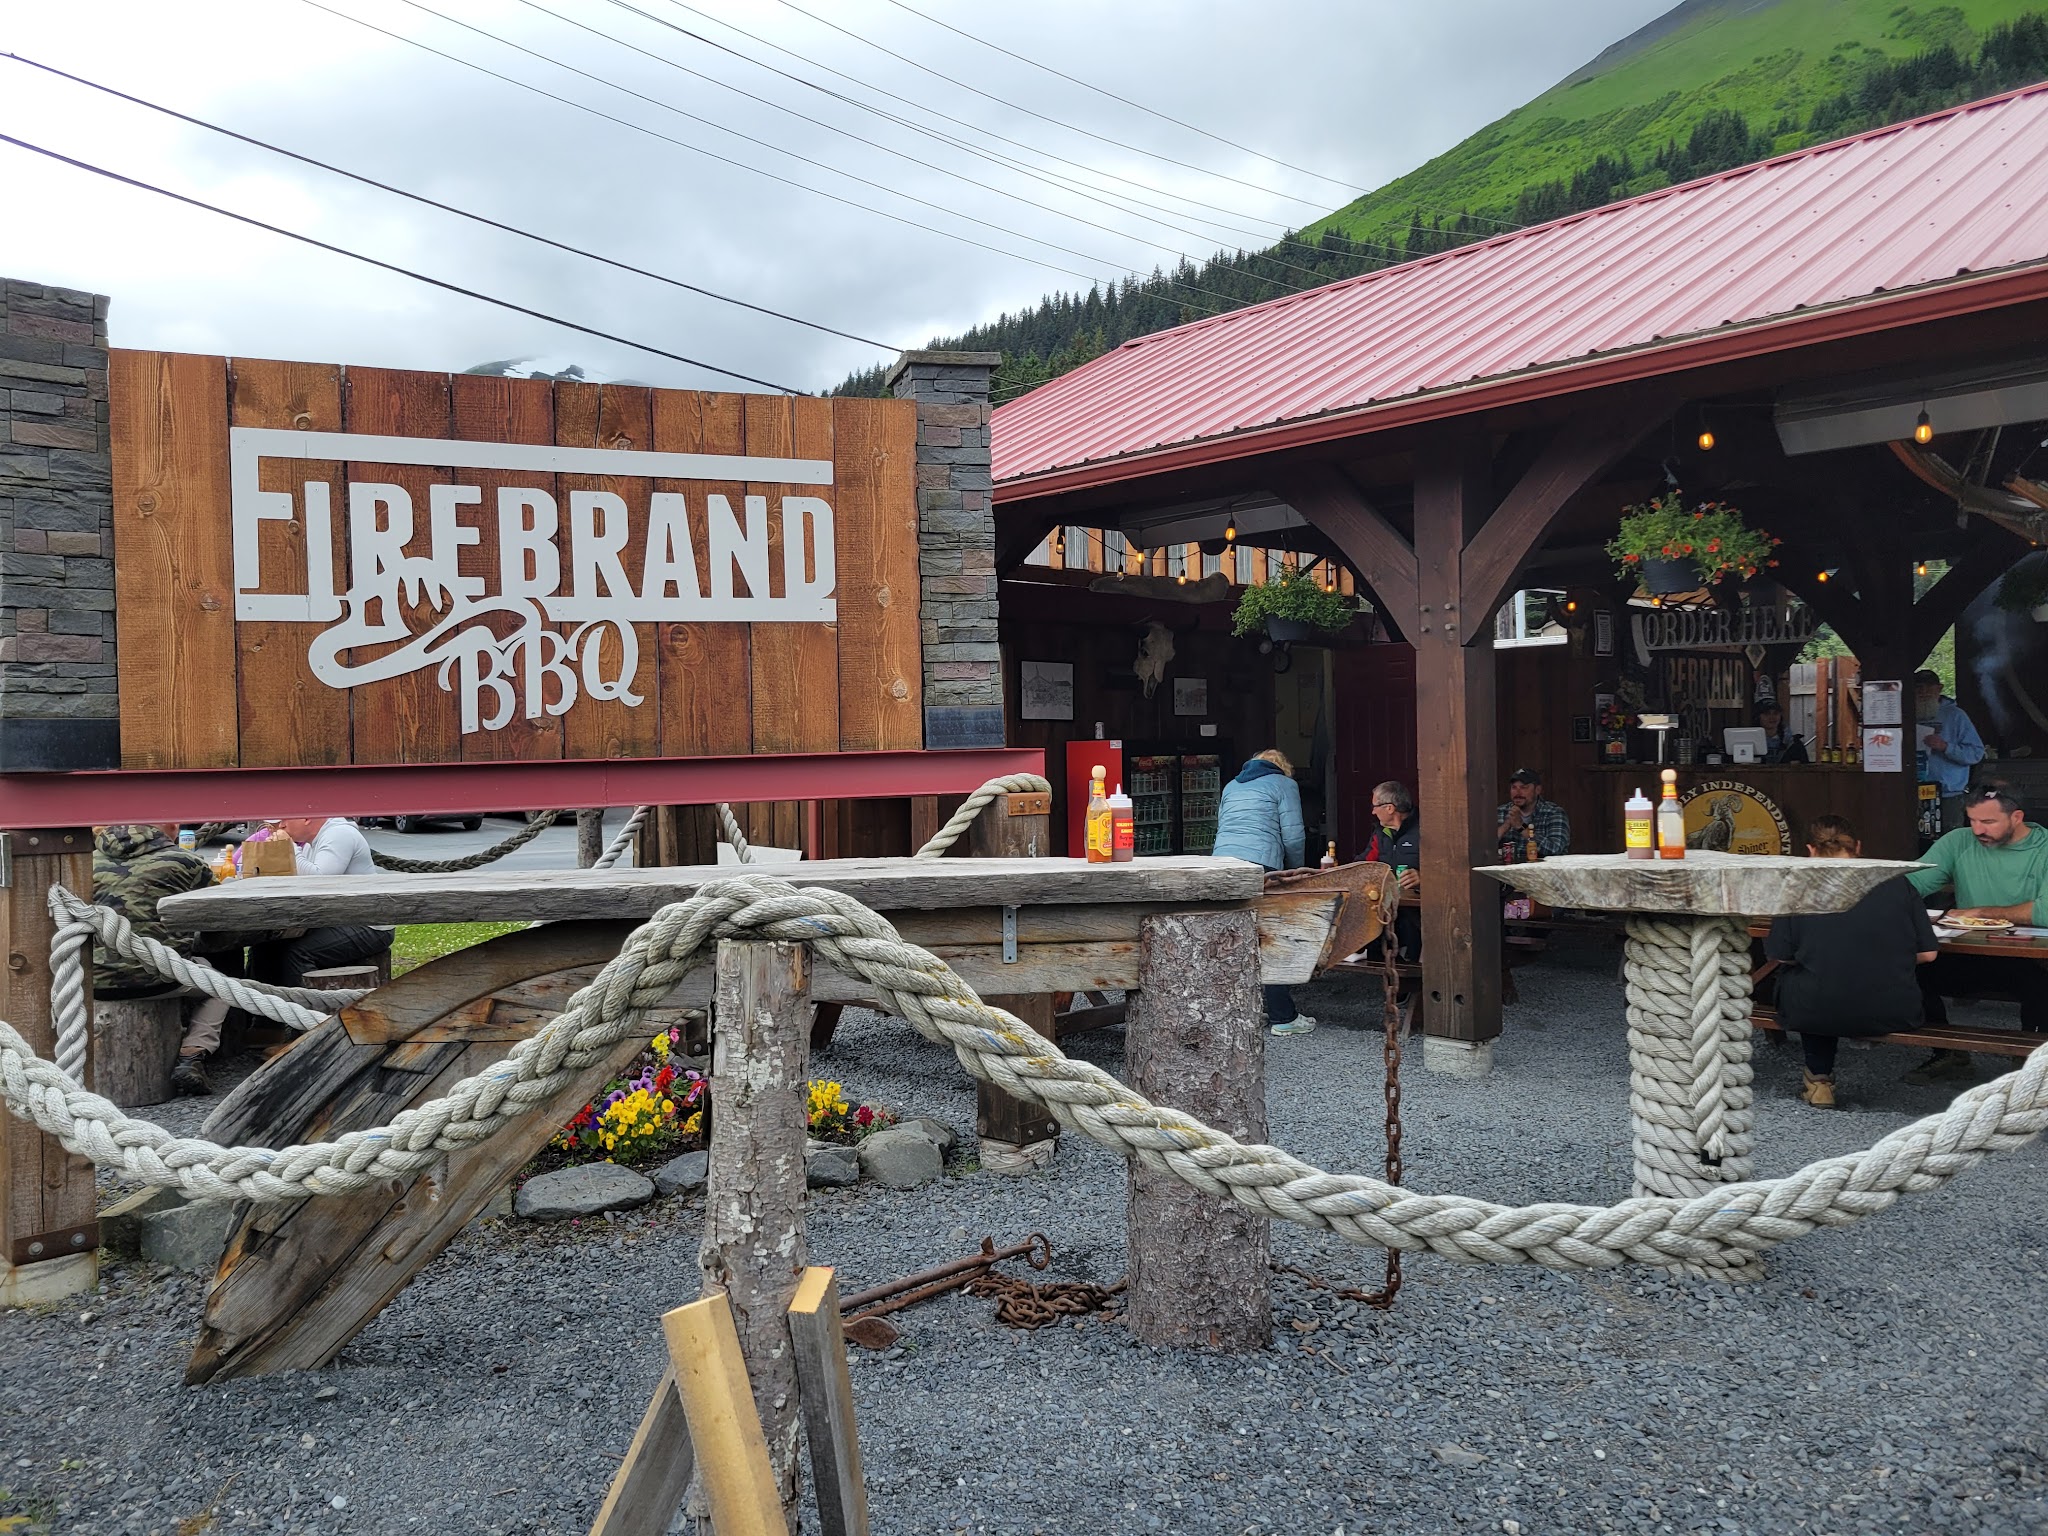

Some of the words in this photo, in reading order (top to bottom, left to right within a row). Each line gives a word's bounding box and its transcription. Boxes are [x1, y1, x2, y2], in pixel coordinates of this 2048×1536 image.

[230, 427, 837, 603] FIREBRAND
[1644, 609, 1732, 647] ORDER
[1740, 603, 1815, 643] HERE
[437, 619, 645, 735] BBQ
[1701, 781, 1792, 855] INDEPENDENT
[1737, 841, 1769, 855] Shiner
